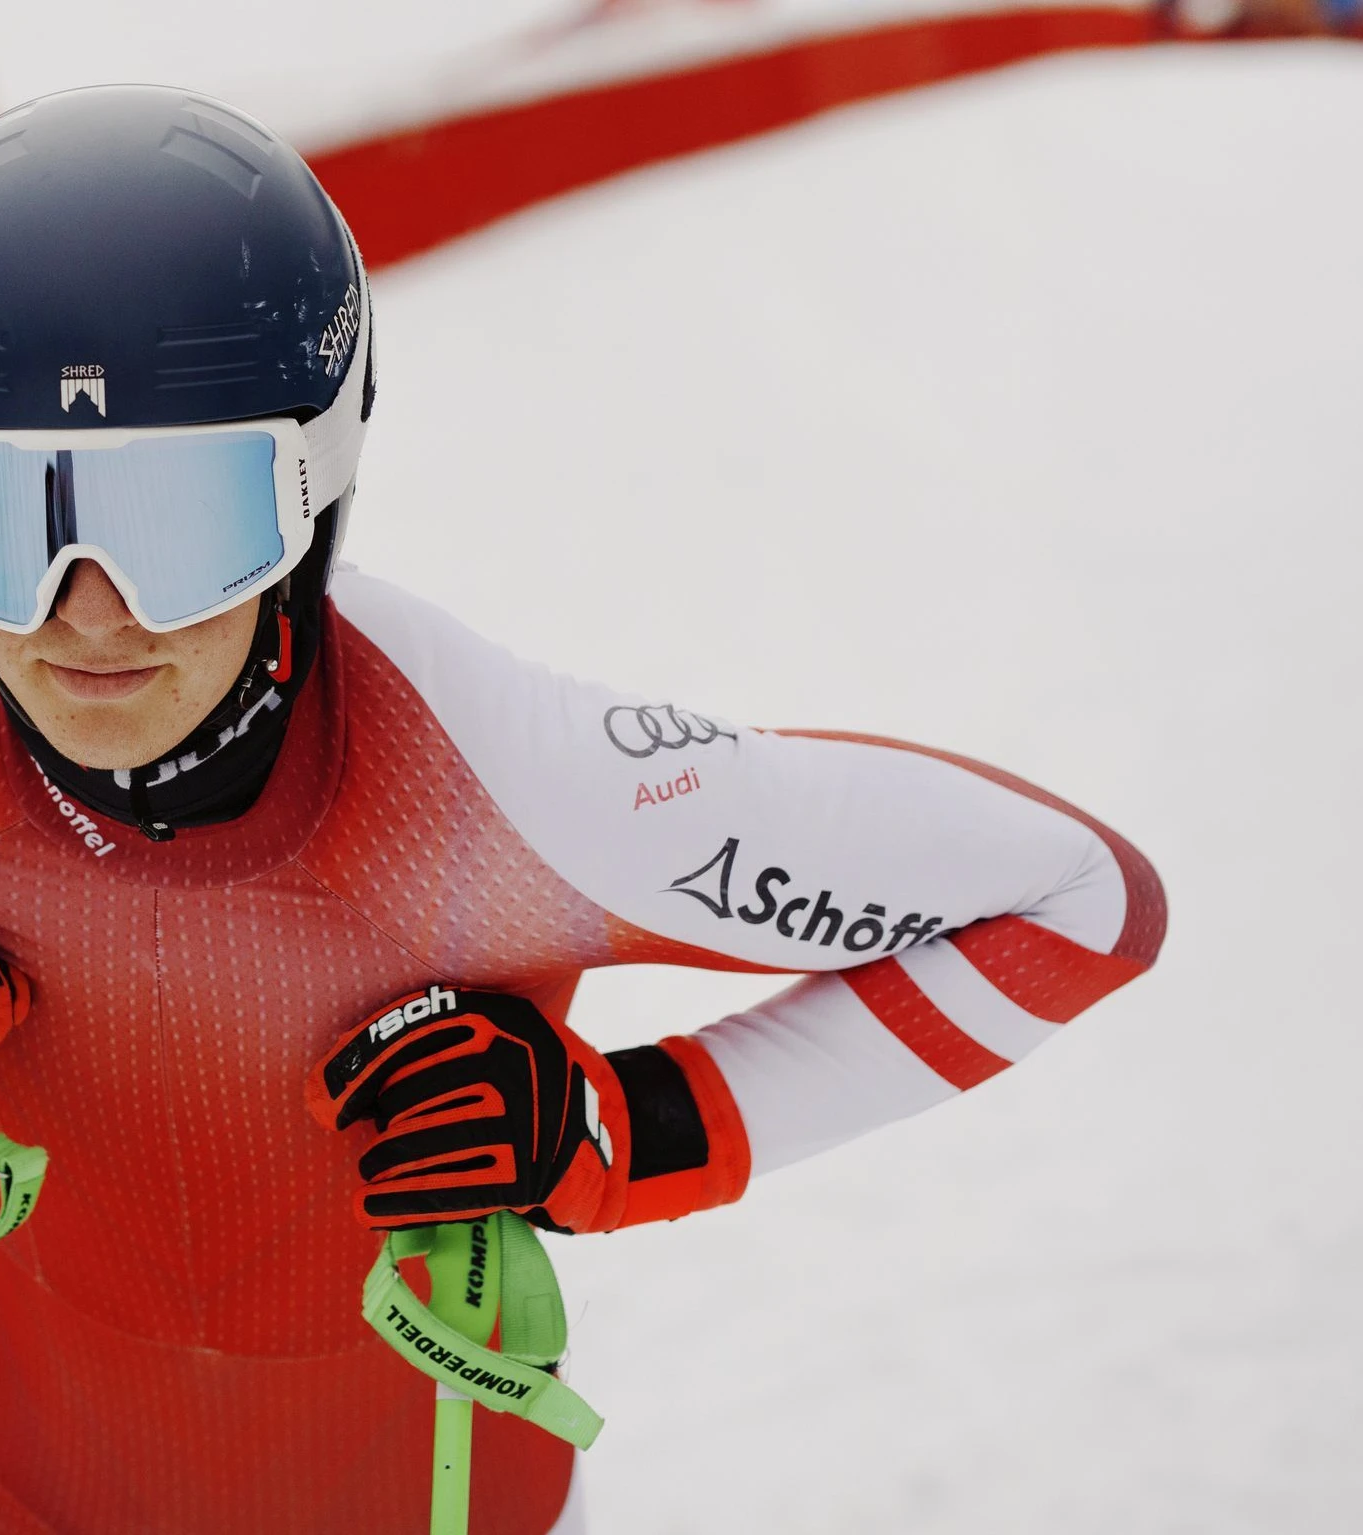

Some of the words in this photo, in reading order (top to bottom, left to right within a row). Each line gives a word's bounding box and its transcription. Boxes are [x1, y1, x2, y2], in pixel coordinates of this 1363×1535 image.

[61, 365, 105, 377] SHRED
[299, 458, 311, 519] OAKLEY
[222, 561, 271, 593] PRIZM
[634, 766, 701, 811] Audi
[386, 1304, 532, 1400] KOMPERDELL
